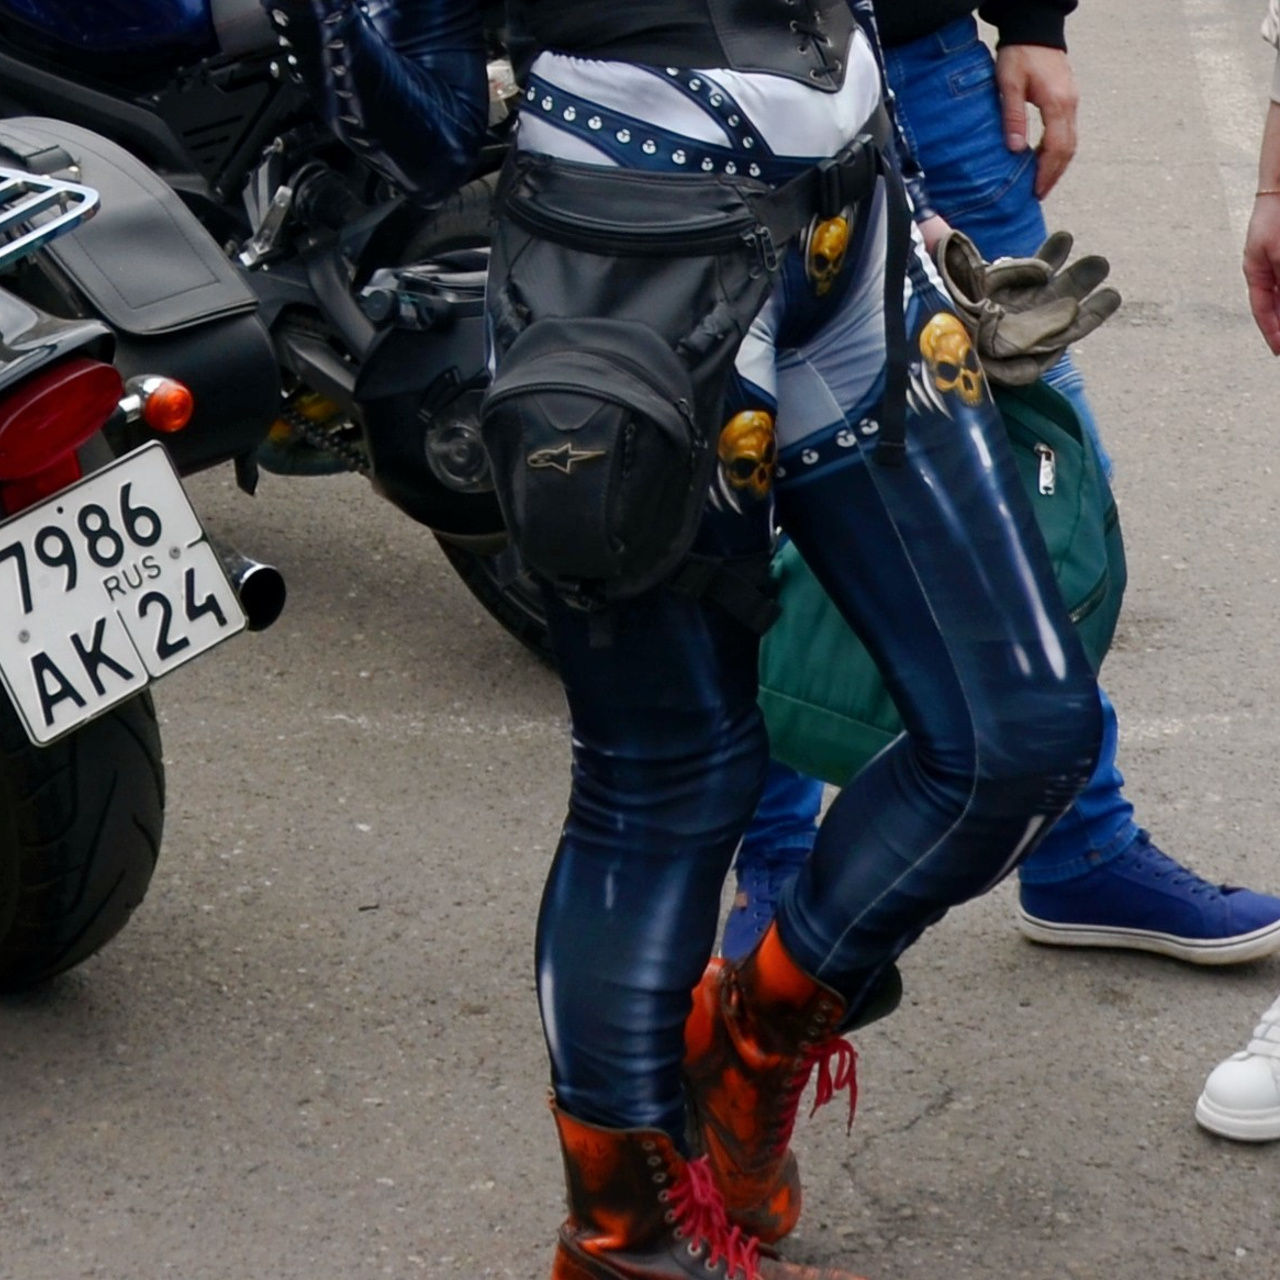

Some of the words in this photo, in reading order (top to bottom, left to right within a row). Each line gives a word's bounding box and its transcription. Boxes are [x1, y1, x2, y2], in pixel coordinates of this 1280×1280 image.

[102, 555, 162, 602] RUS
[30, 617, 135, 727] AK
[138, 567, 227, 661] 24
